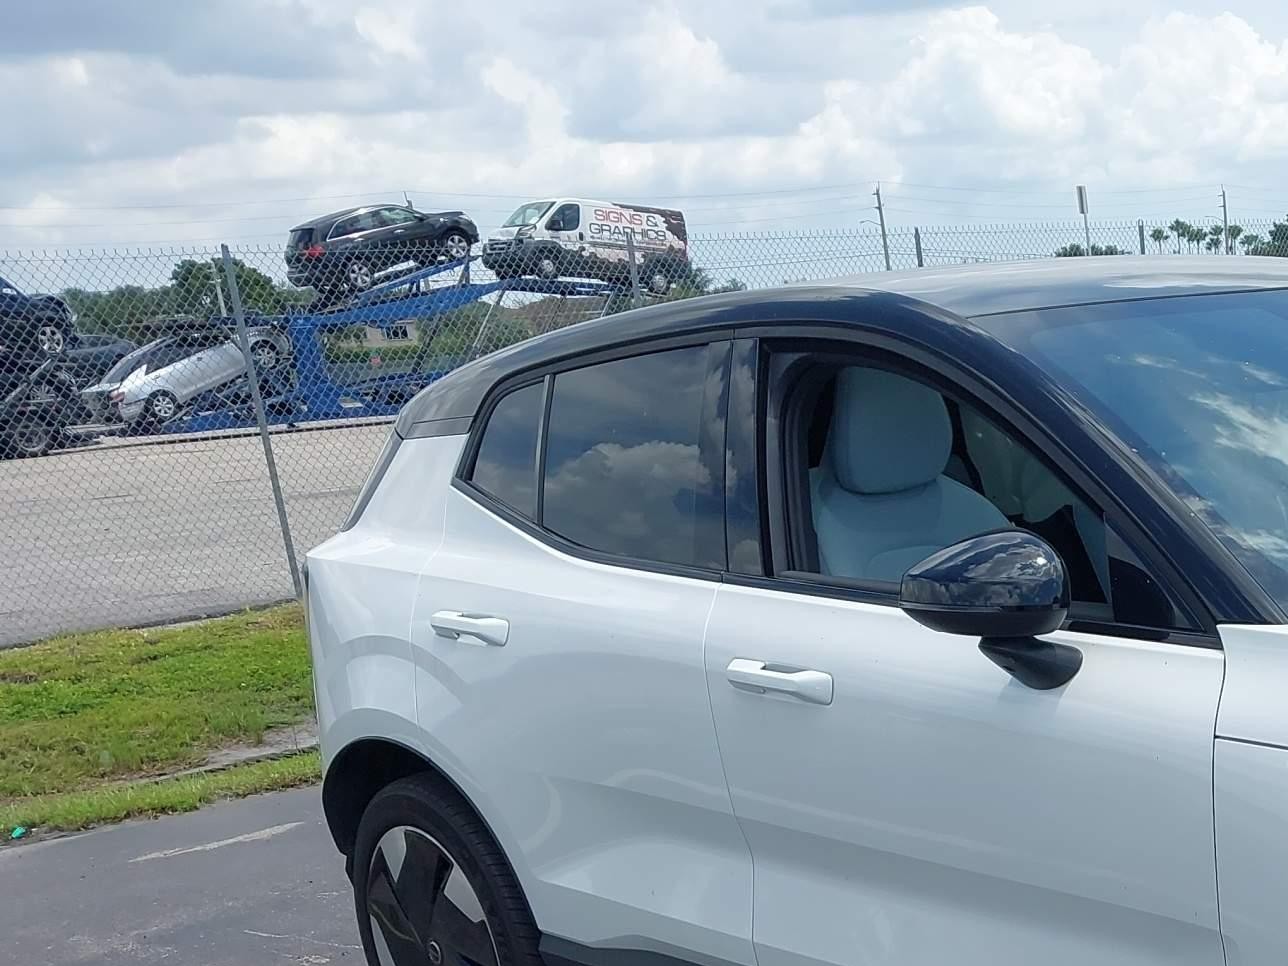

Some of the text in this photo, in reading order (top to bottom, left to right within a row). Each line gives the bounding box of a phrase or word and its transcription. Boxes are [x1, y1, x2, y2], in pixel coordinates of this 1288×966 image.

[594, 209, 660, 227] SIGNS &
[589, 222, 667, 241] GRAPHICS
